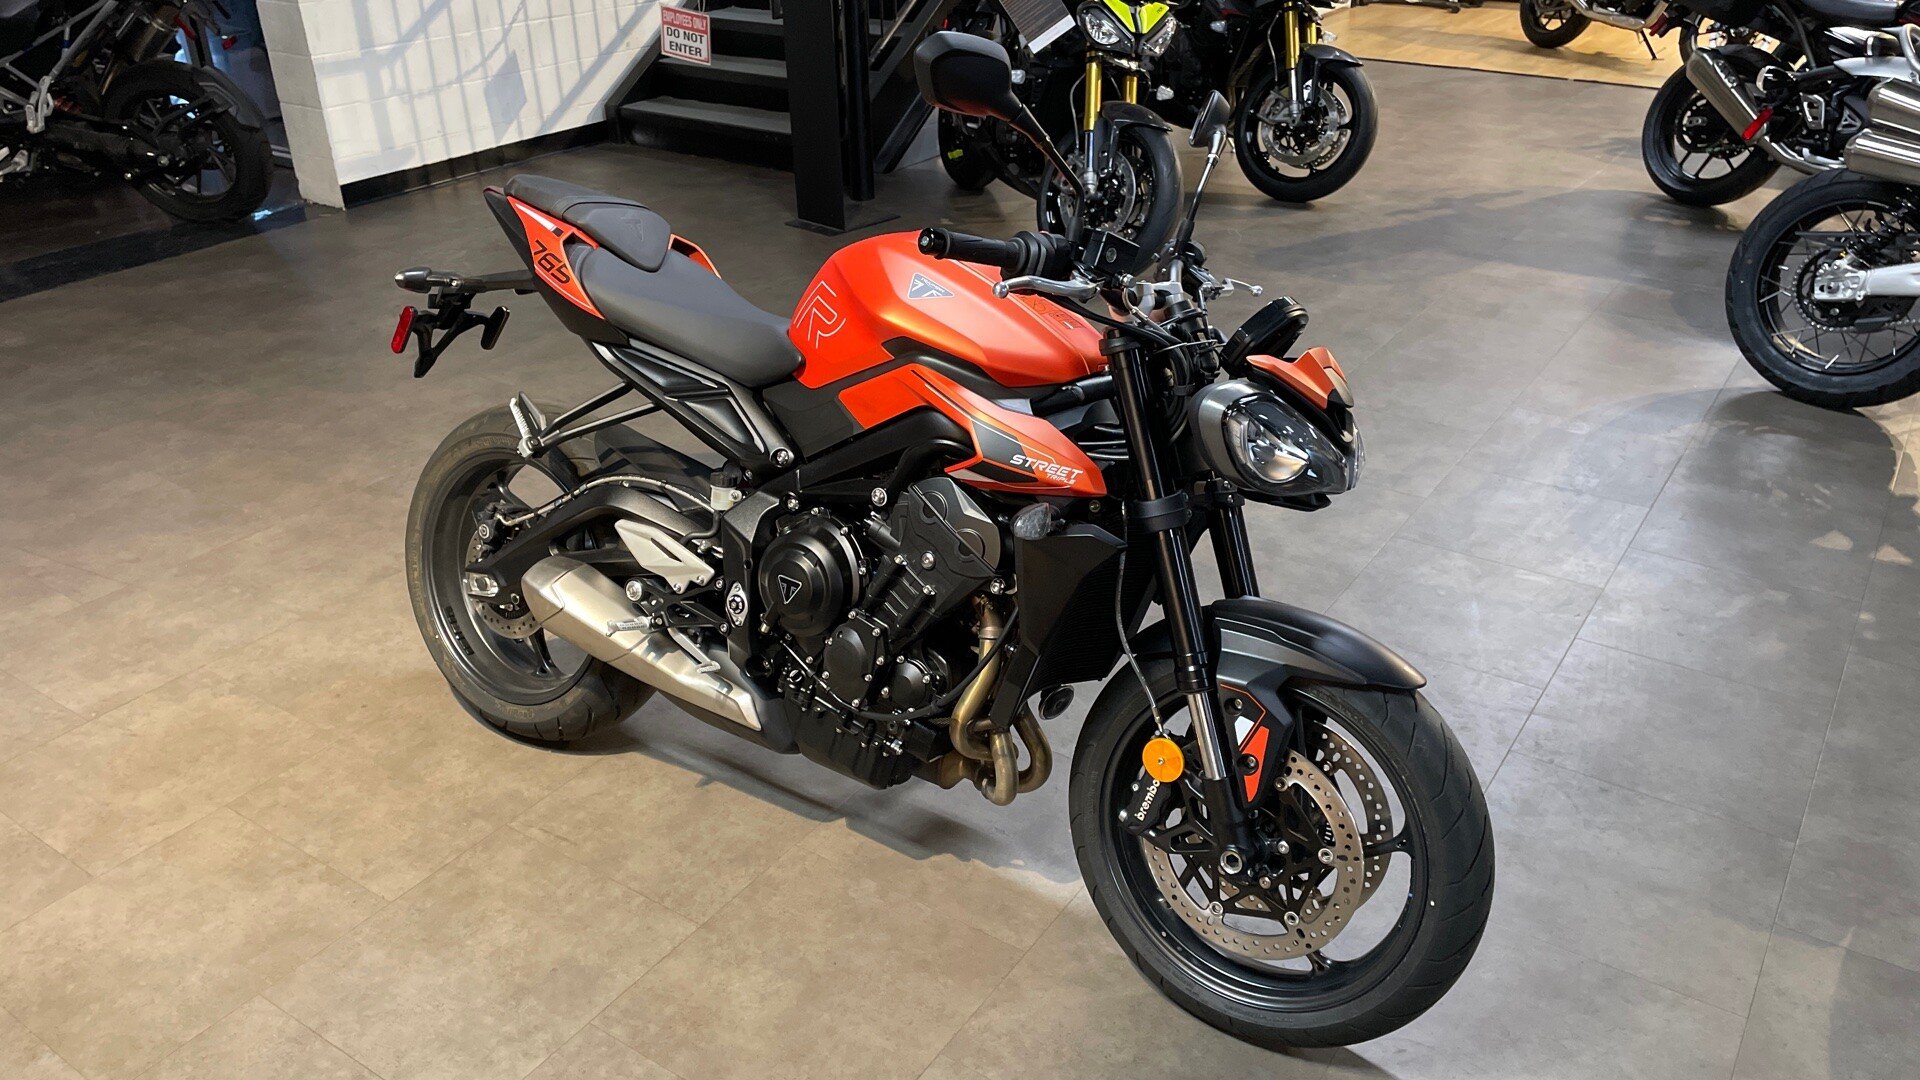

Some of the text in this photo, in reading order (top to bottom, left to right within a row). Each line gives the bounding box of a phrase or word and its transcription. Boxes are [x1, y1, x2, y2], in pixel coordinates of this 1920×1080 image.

[666, 26, 704, 44] DO NOT
[669, 41, 702, 57] ENTER
[533, 240, 571, 284] 765
[1009, 454, 1084, 480] STREET
[1046, 473, 1077, 485] TRIPLE
[1133, 779, 1161, 822] brembo
